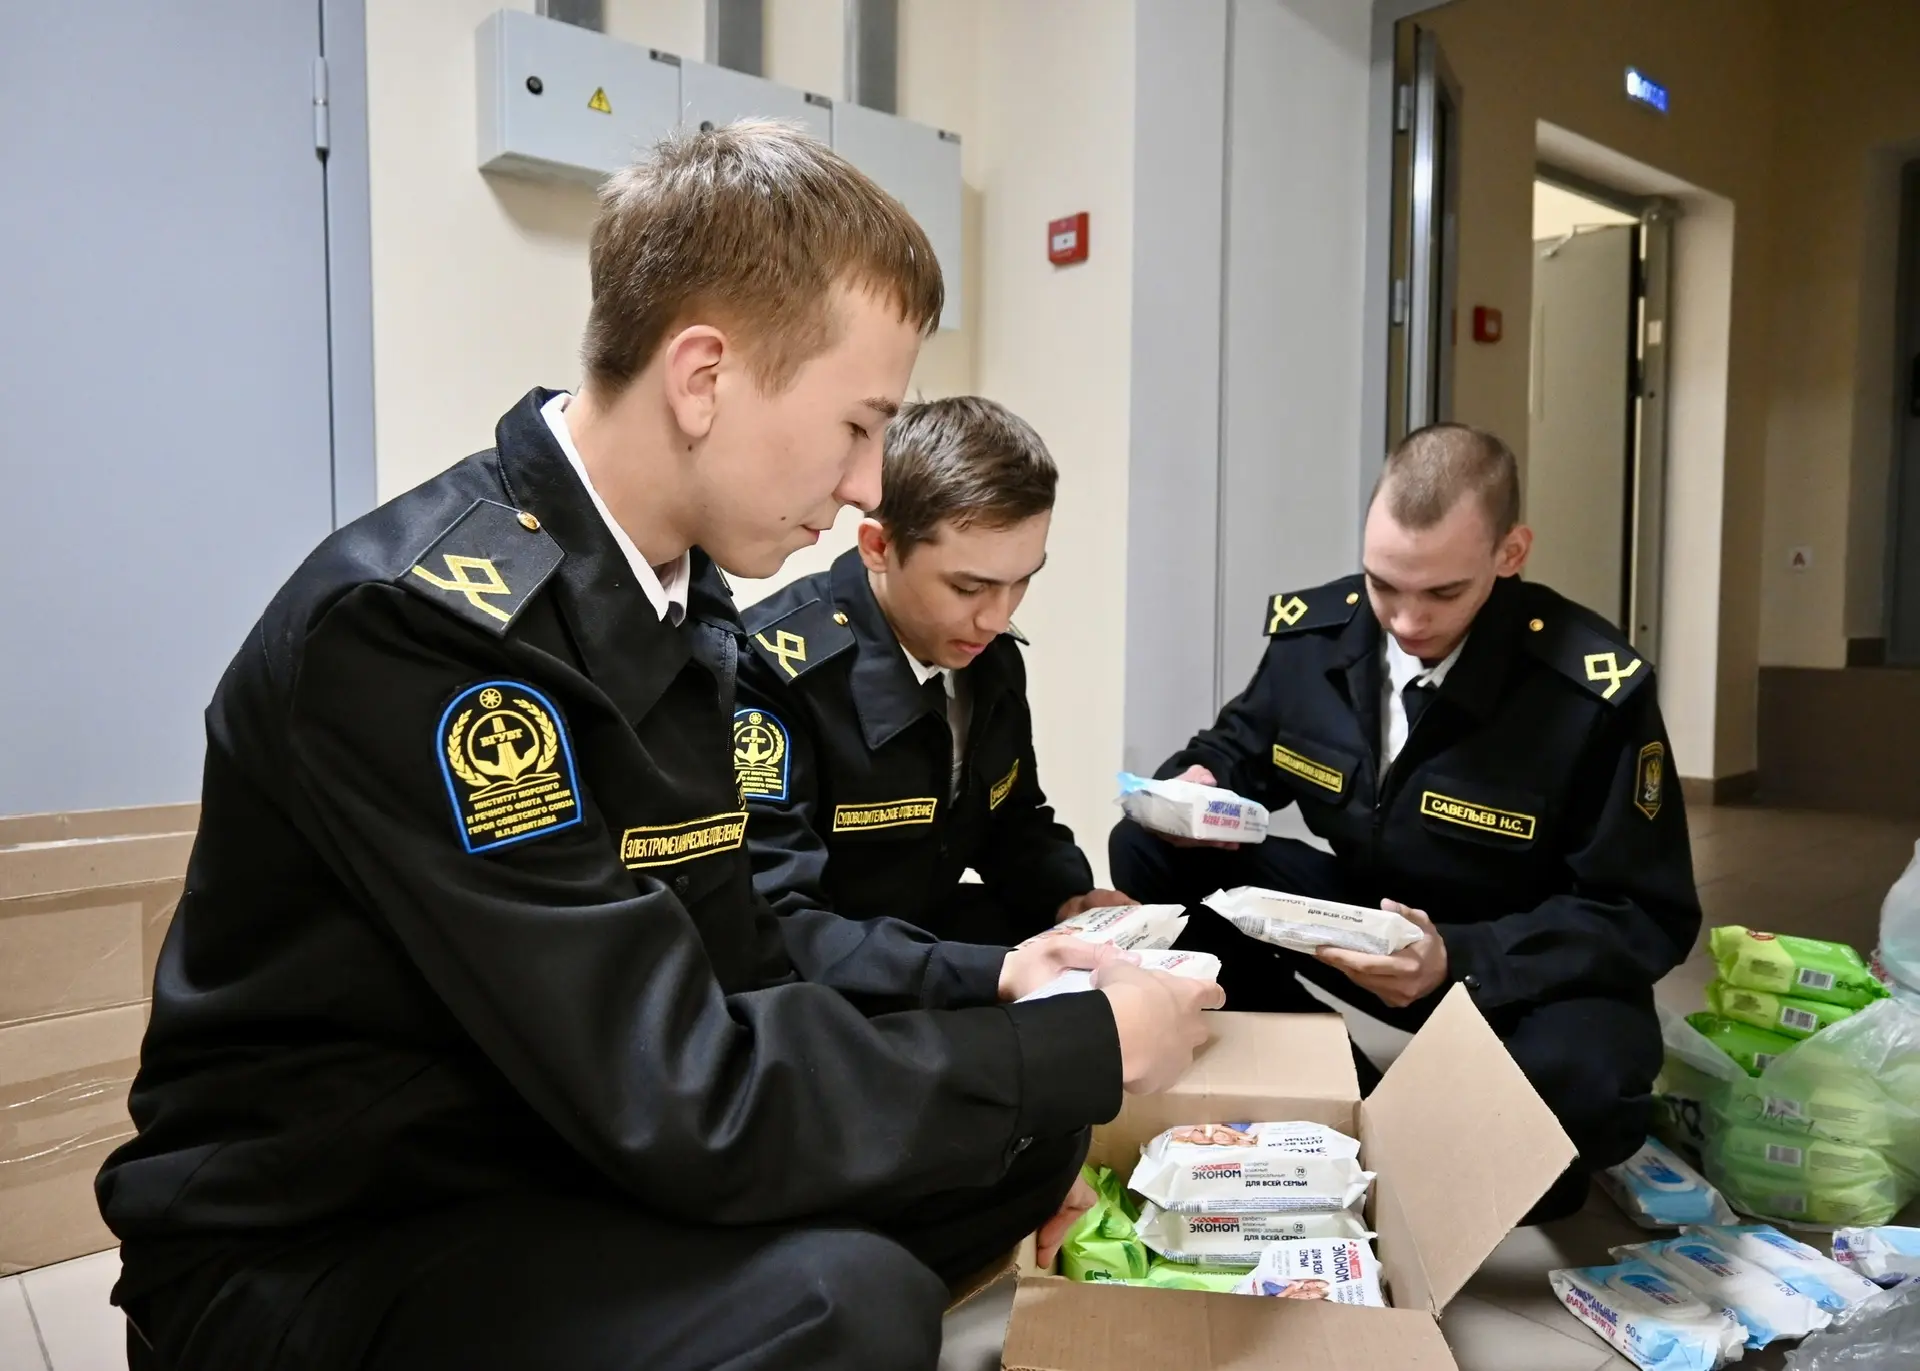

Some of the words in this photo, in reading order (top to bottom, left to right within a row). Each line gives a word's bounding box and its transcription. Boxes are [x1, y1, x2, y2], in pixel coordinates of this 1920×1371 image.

[474, 792, 517, 810] ИНСТИТУТ
[518, 782, 559, 798] МОРСКОГО
[466, 815, 474, 824] И
[474, 804, 513, 821] РЕЧНОГО
[514, 797, 542, 810] ФЛОТА
[544, 789, 571, 802] ИМЕНИ
[1431, 799, 1497, 826] САВЕЛЬЕВ
[1500, 816, 1524, 832] Н.С.
[468, 821, 495, 835] ГЕРОЯ
[548, 799, 575, 812] СОЮЗА
[1191, 1169, 1241, 1180] ЭКОНОМ
[1262, 1179, 1281, 1187] ВСЕЙ
[1189, 1223, 1240, 1233] ЭКОНОМ
[1243, 1234, 1259, 1242] ДЛЯ
[1261, 1233, 1280, 1241] ВСЕЙ
[1299, 1249, 1309, 1267] СЕМЬИ
[1313, 1259, 1324, 1275] ВСЕЙ
[1332, 1243, 1350, 1283] ЭКОНОМ
